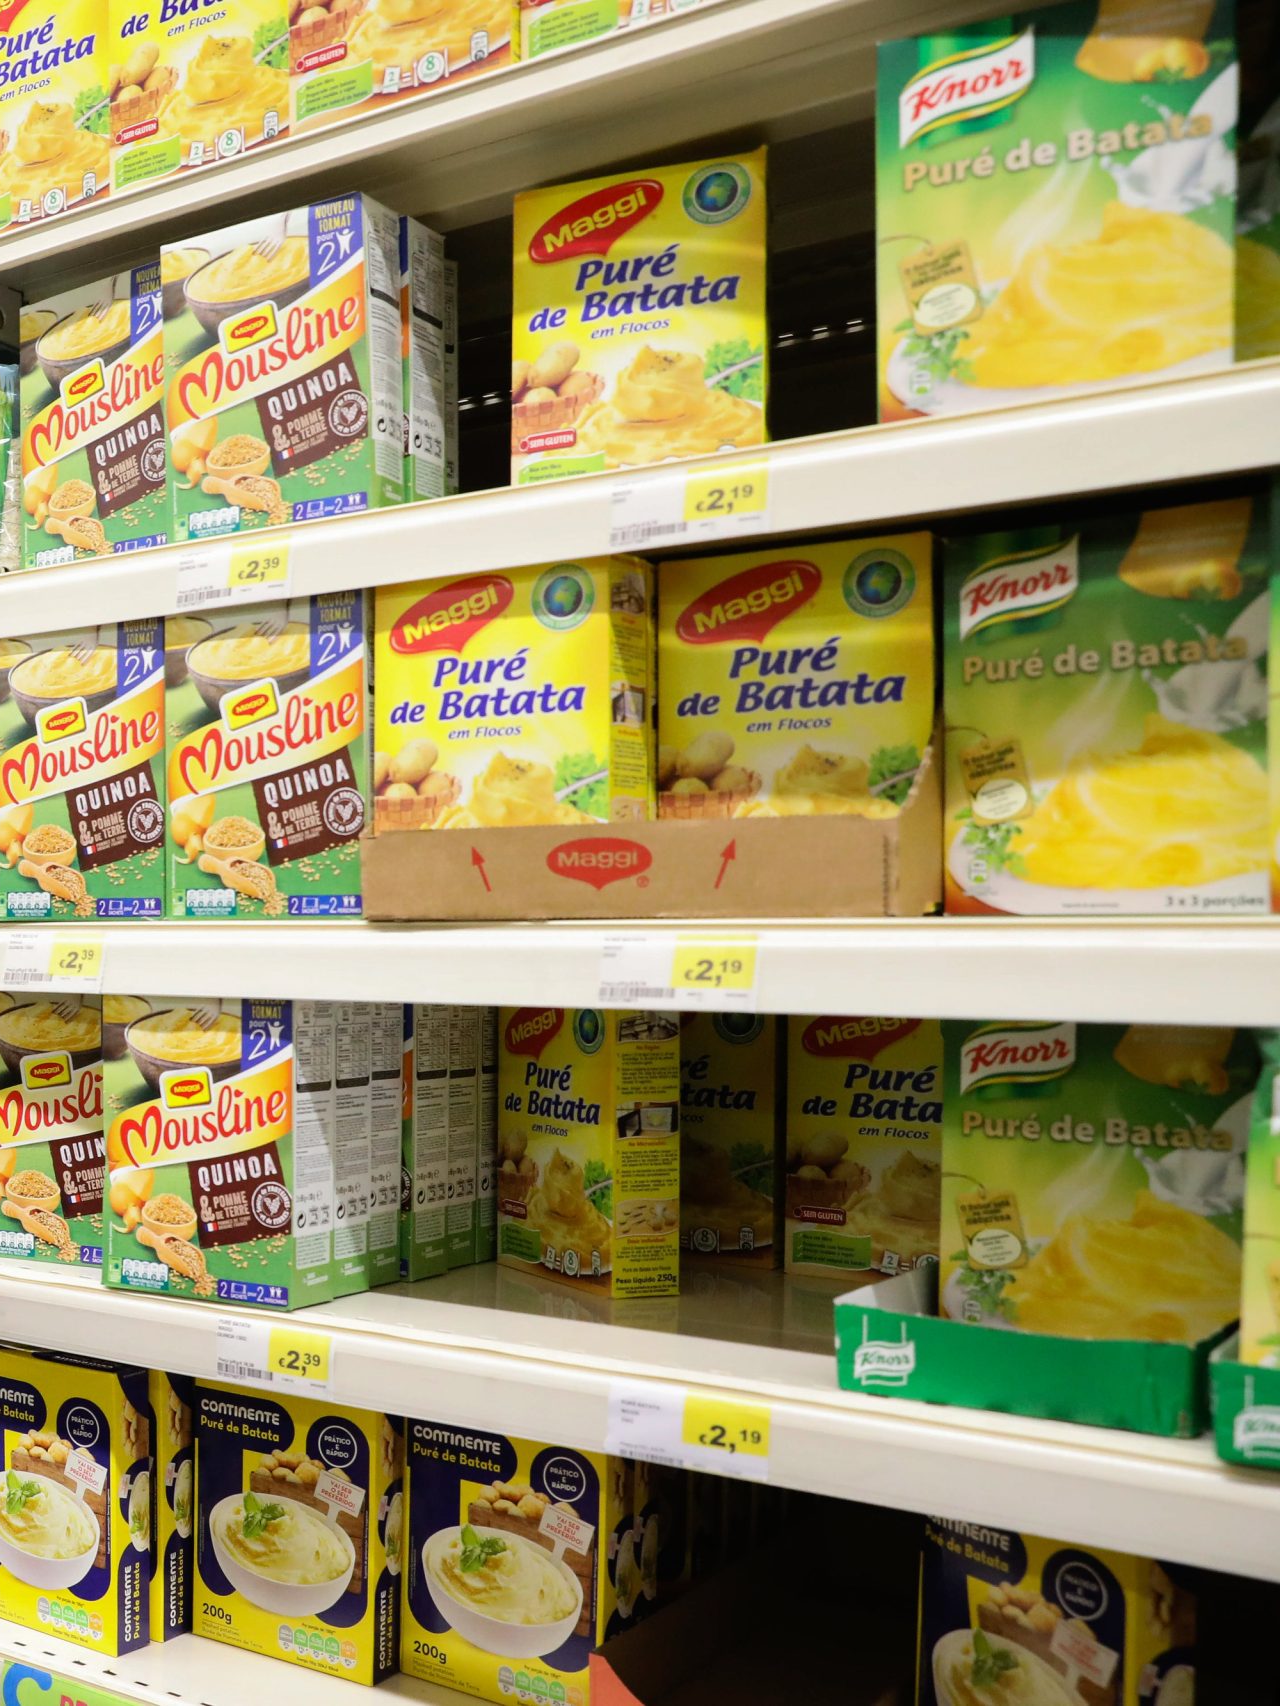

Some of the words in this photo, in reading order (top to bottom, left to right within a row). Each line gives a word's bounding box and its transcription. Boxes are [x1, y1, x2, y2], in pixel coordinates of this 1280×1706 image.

[120, 13, 149, 39] de
[189, 8, 227, 30] Flocos
[0, 92, 16, 103] em
[18, 77, 51, 97] Flocos
[905, 58, 1029, 122] Knorr
[903, 146, 995, 191] Puré
[1004, 137, 1057, 172] de
[1067, 113, 1213, 160] Batata
[314, 199, 355, 220] NOUVEAU
[318, 214, 351, 233] FORMAT
[542, 186, 647, 254] Maggi
[316, 242, 336, 276] 2
[575, 243, 680, 291] Puré
[528, 306, 566, 333] de
[581, 273, 741, 322] Batata
[590, 327, 615, 340] em
[619, 318, 671, 335] Flocos
[179, 296, 360, 420] Mousline
[267, 363, 353, 420] QUINOA
[30, 353, 163, 467] Mousline
[287, 407, 323, 433] POMME
[95, 414, 162, 467] QUINOA
[303, 420, 327, 439] TERRE
[695, 484, 753, 514] €2,19
[237, 556, 280, 585] €2,39
[692, 569, 804, 634] Maggi
[965, 564, 1072, 616] Knorr
[319, 606, 353, 622] FORMAT
[401, 583, 499, 646] Maggi
[317, 633, 336, 666] 2
[729, 637, 842, 680] Puré
[963, 651, 1044, 685] Puré
[1053, 645, 1101, 675] de
[1111, 636, 1249, 669] Batata
[433, 648, 528, 687] Puré
[390, 701, 425, 724] de
[439, 683, 586, 721] Batata
[677, 694, 720, 718] de
[735, 673, 908, 714] Batata
[448, 728, 471, 740] em
[475, 724, 522, 738] Flocos
[746, 721, 772, 734] em
[774, 716, 833, 732] Flocos
[2, 711, 159, 805] Mousline
[178, 691, 360, 796] Mousline
[75, 771, 151, 813] QUINOA
[264, 758, 351, 807] QUINOA
[281, 802, 319, 826] POMME
[298, 817, 323, 835] TERRE
[557, 849, 638, 869] Maggi
[59, 948, 95, 974] €2,39
[684, 959, 742, 987] €2,19
[249, 1029, 267, 1061] 2
[964, 1037, 1070, 1075] Knorr
[173, 1082, 204, 1095] Maggi
[524, 1061, 572, 1092] Puré
[845, 1063, 937, 1094] Puré
[504, 1093, 522, 1113] de
[527, 1089, 601, 1126] Batata
[802, 1097, 838, 1118] de
[120, 1088, 288, 1169] Mousline
[544, 1125, 569, 1138] Flocos
[859, 1127, 881, 1138] em
[884, 1126, 930, 1140] Flocos
[962, 1112, 1041, 1142] Puré
[1050, 1113, 1095, 1143] de
[1105, 1118, 1233, 1151] Batata
[198, 1154, 277, 1191] QUINOA
[213, 1191, 248, 1208] POMME
[226, 1202, 251, 1217] TERRE
[278, 1350, 321, 1376] €2,39
[859, 1350, 910, 1368] Knorr
[3, 1407, 35, 1423] Batata
[201, 1398, 280, 1426] CONTINENTE
[201, 1414, 223, 1431] Puré
[226, 1420, 239, 1434] de
[242, 1426, 280, 1443] Batata
[324, 1434, 351, 1446] PRÁTICO
[413, 1425, 501, 1456] CONTINENTE
[699, 1424, 761, 1454] €2,19
[326, 1449, 349, 1459] RÁPIDO
[413, 1442, 438, 1459] Puré
[442, 1451, 457, 1464] de
[459, 1455, 501, 1473] Batata
[549, 1467, 580, 1479] PRÁTICO
[551, 1481, 577, 1493] RÁPIDO
[546, 1522, 583, 1546] PREFERIDO!
[123, 1564, 132, 1642] CONTINENTE
[202, 1601, 233, 1626] 200g
[413, 1640, 448, 1665] 200g
